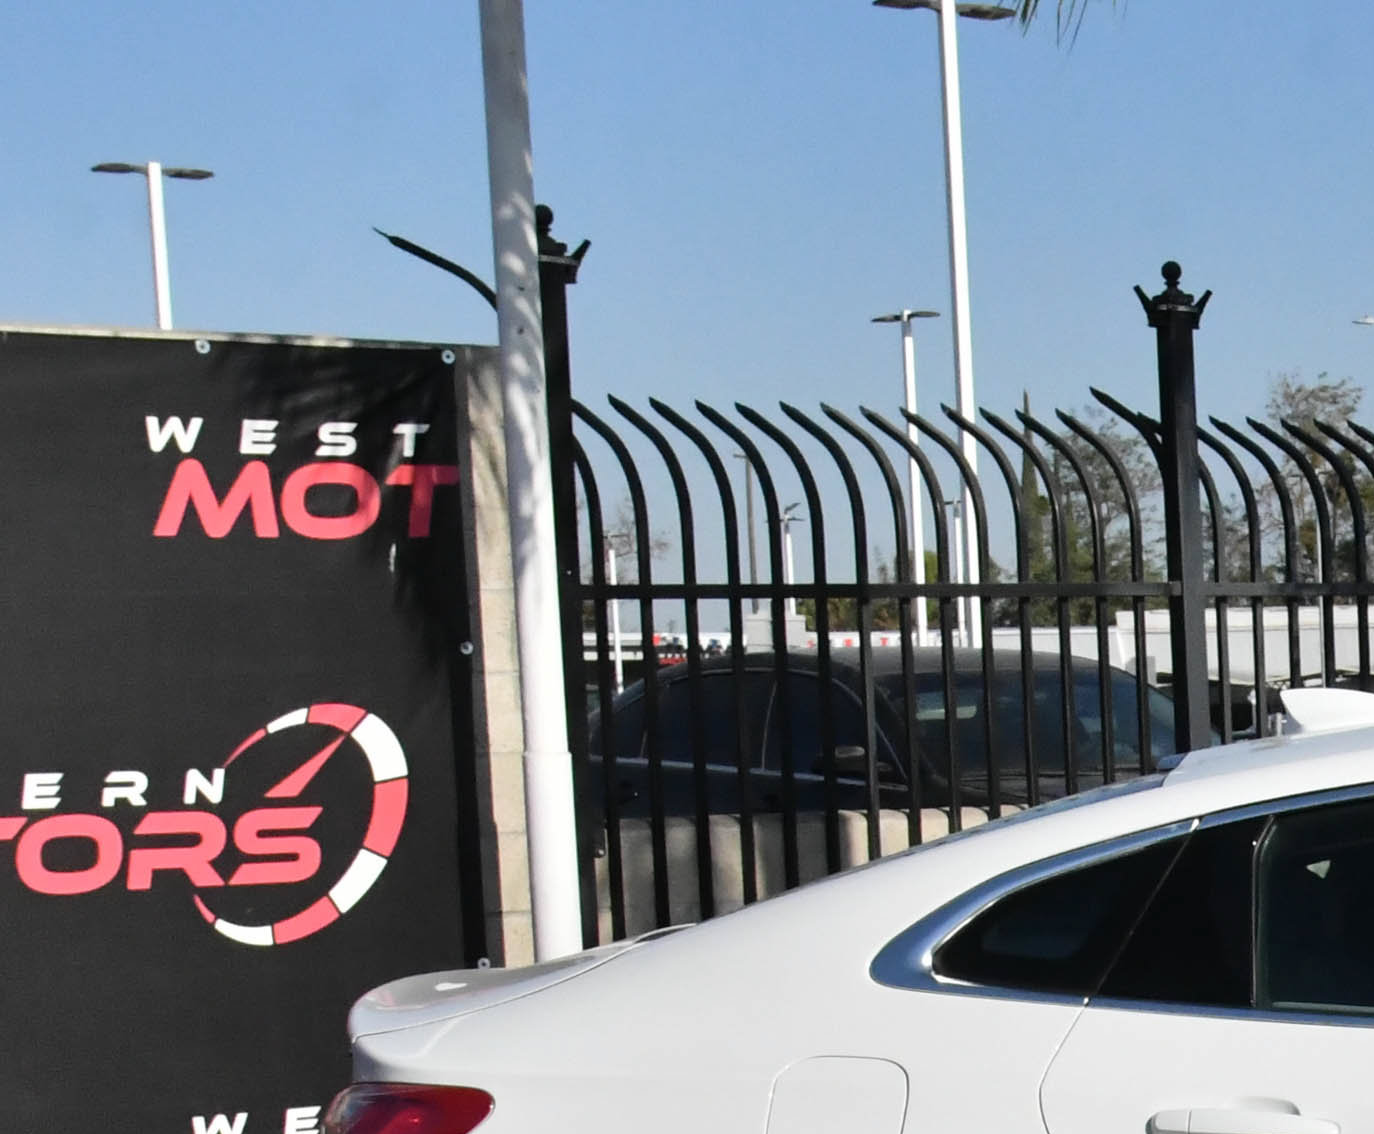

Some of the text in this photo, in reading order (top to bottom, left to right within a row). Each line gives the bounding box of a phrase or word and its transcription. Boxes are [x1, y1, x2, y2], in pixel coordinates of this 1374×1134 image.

[144, 415, 430, 458] WEST
[153, 458, 461, 539] MOT
[21, 768, 226, 811] ERN
[0, 806, 323, 896] ORS
